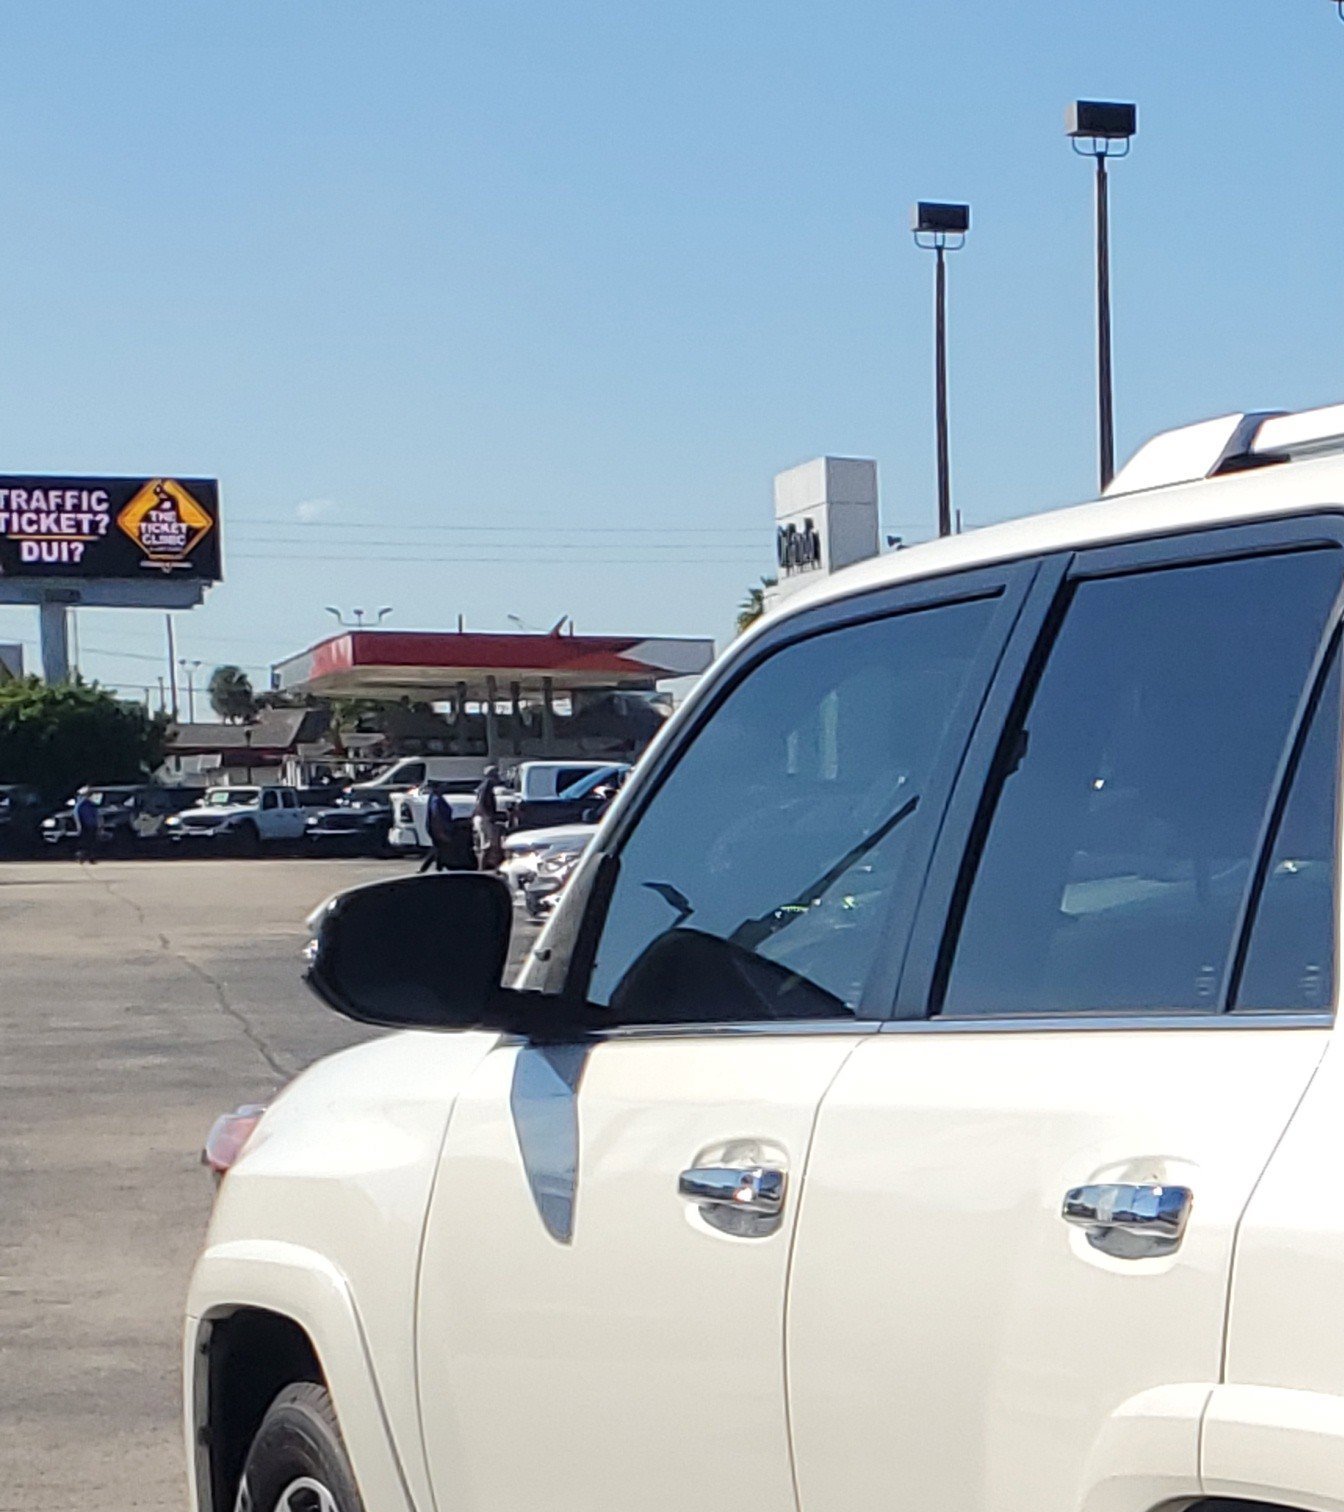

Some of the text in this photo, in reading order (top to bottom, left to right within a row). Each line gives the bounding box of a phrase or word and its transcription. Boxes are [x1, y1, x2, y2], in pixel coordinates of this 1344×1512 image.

[0, 490, 109, 511] TRAFFIC
[0, 513, 110, 535] TICKET?
[140, 523, 187, 534] TICKET
[21, 541, 85, 562] DUI?
